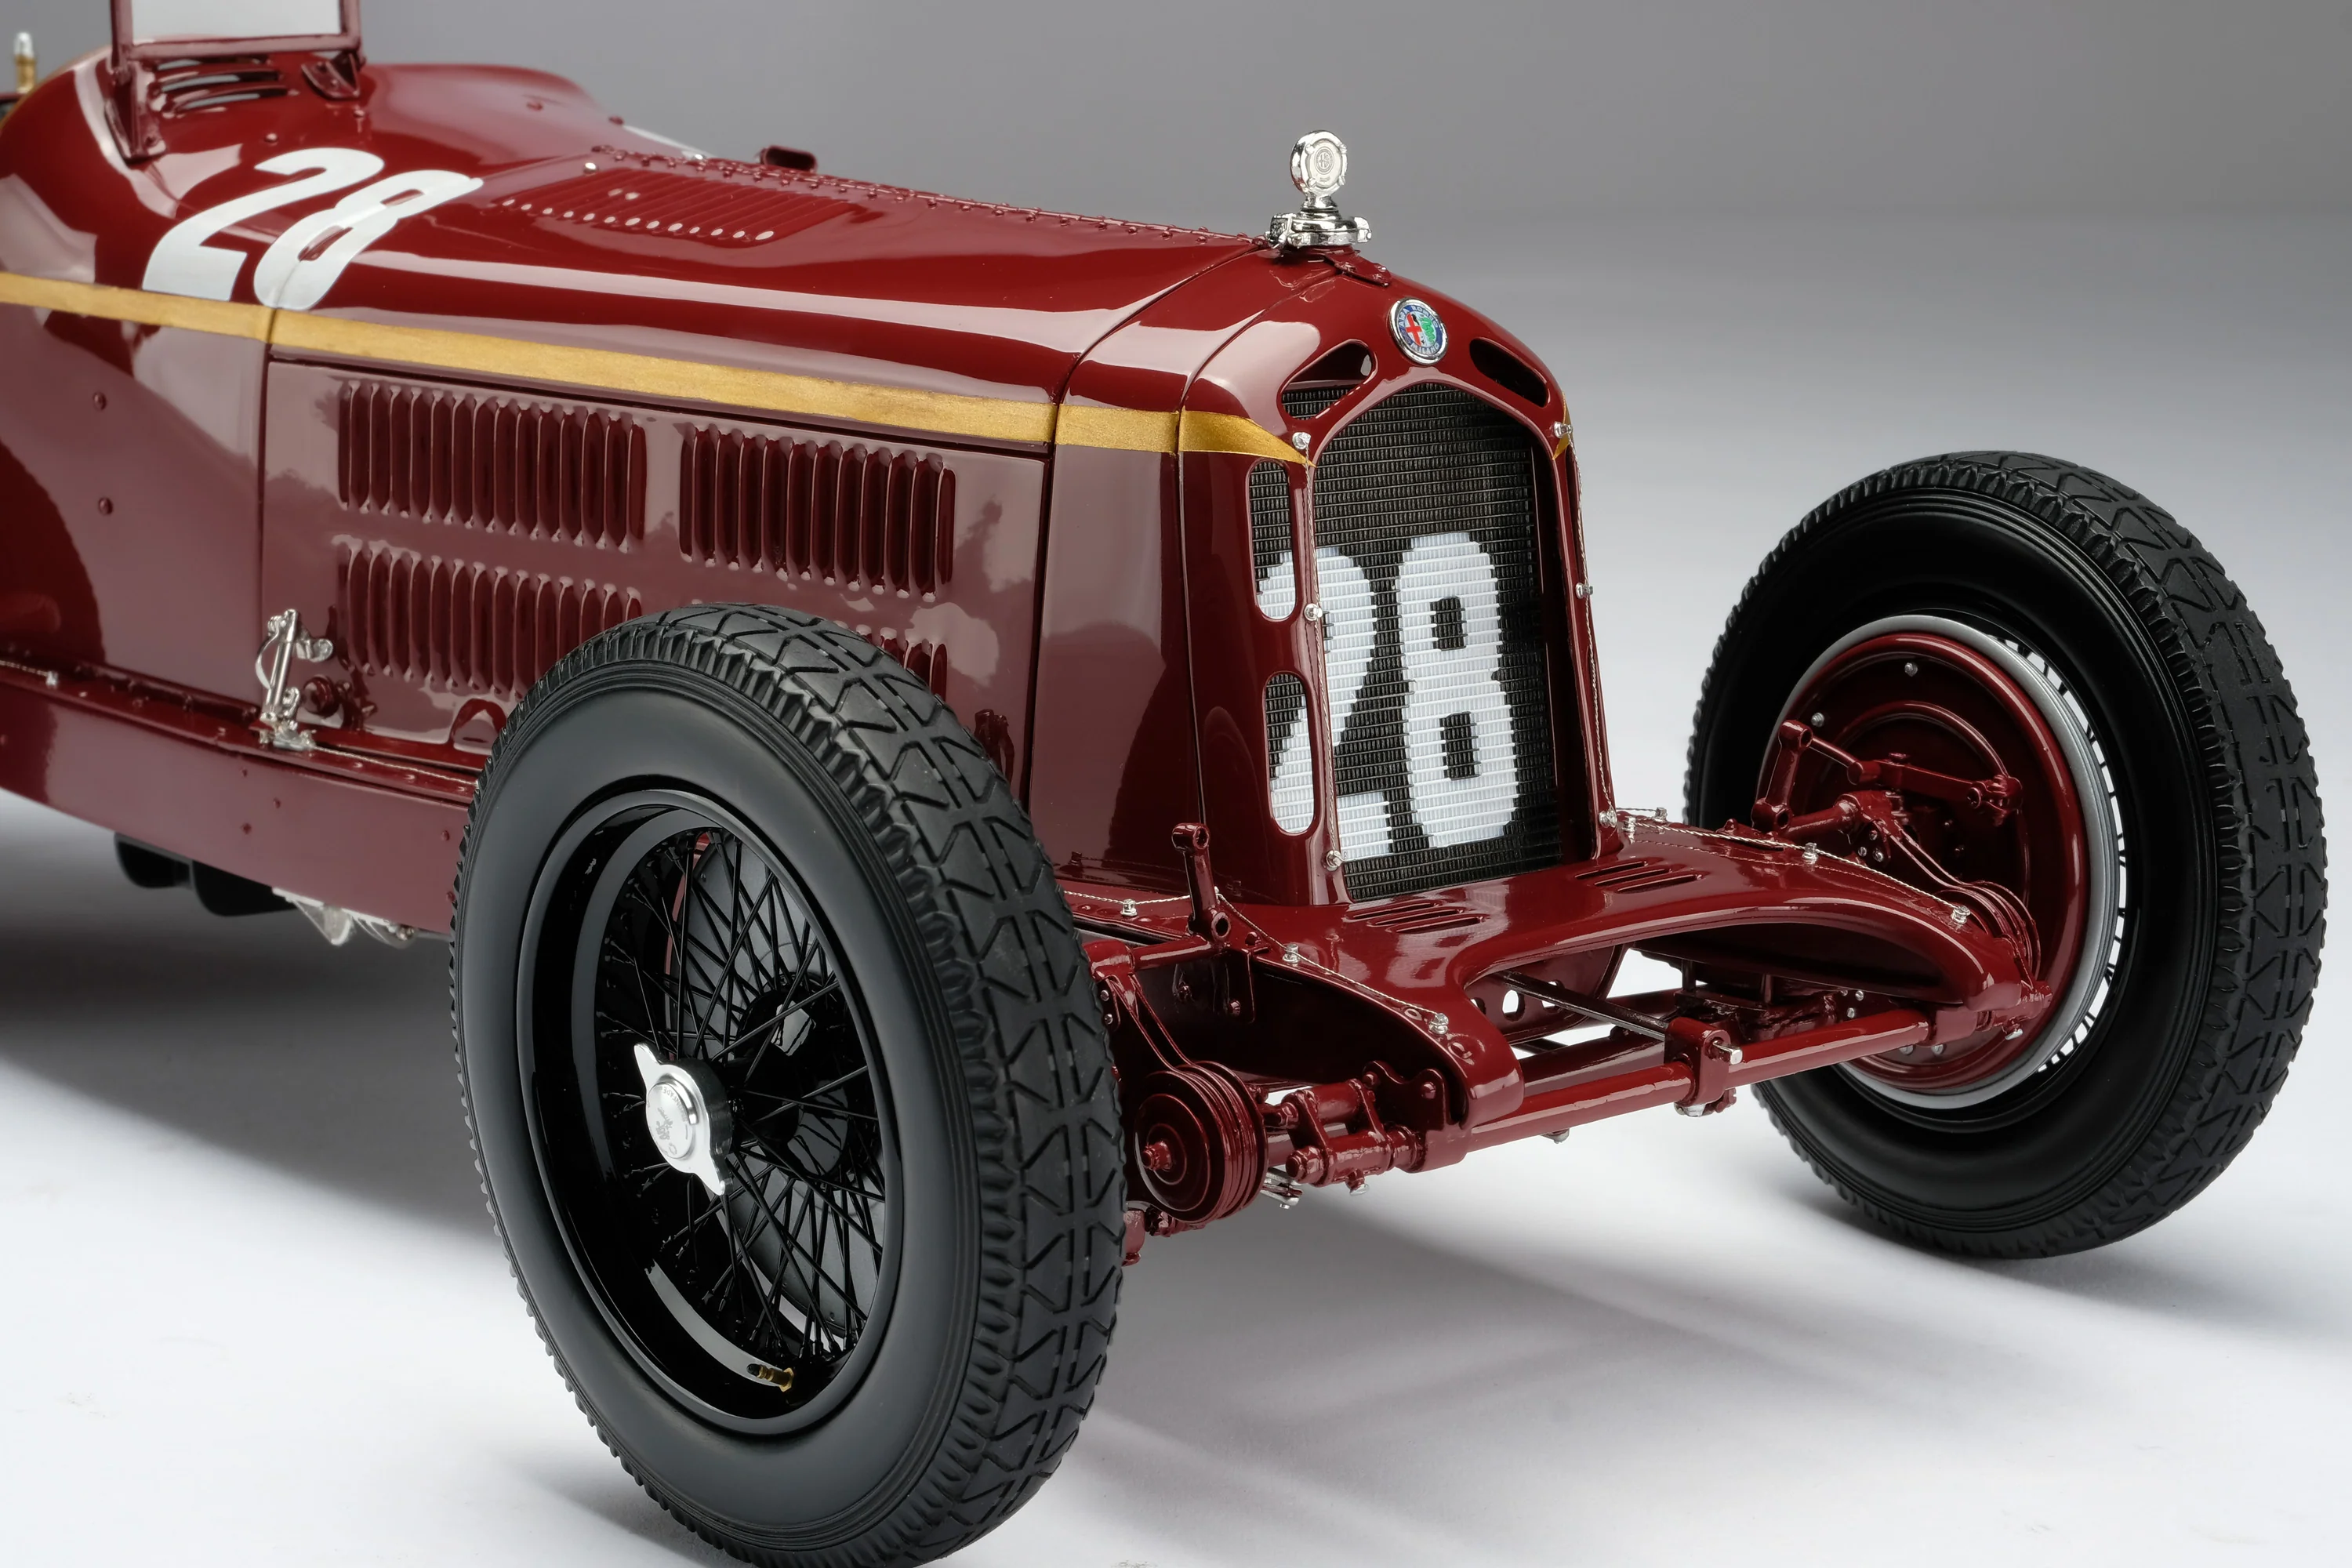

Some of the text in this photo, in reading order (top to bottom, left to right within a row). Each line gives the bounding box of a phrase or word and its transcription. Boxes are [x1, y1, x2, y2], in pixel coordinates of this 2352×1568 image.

[142, 147, 484, 310] 28
[1410, 305, 1438, 328] ROMEO
[1410, 342, 1439, 354] MILANO
[1256, 532, 1519, 862] 28
